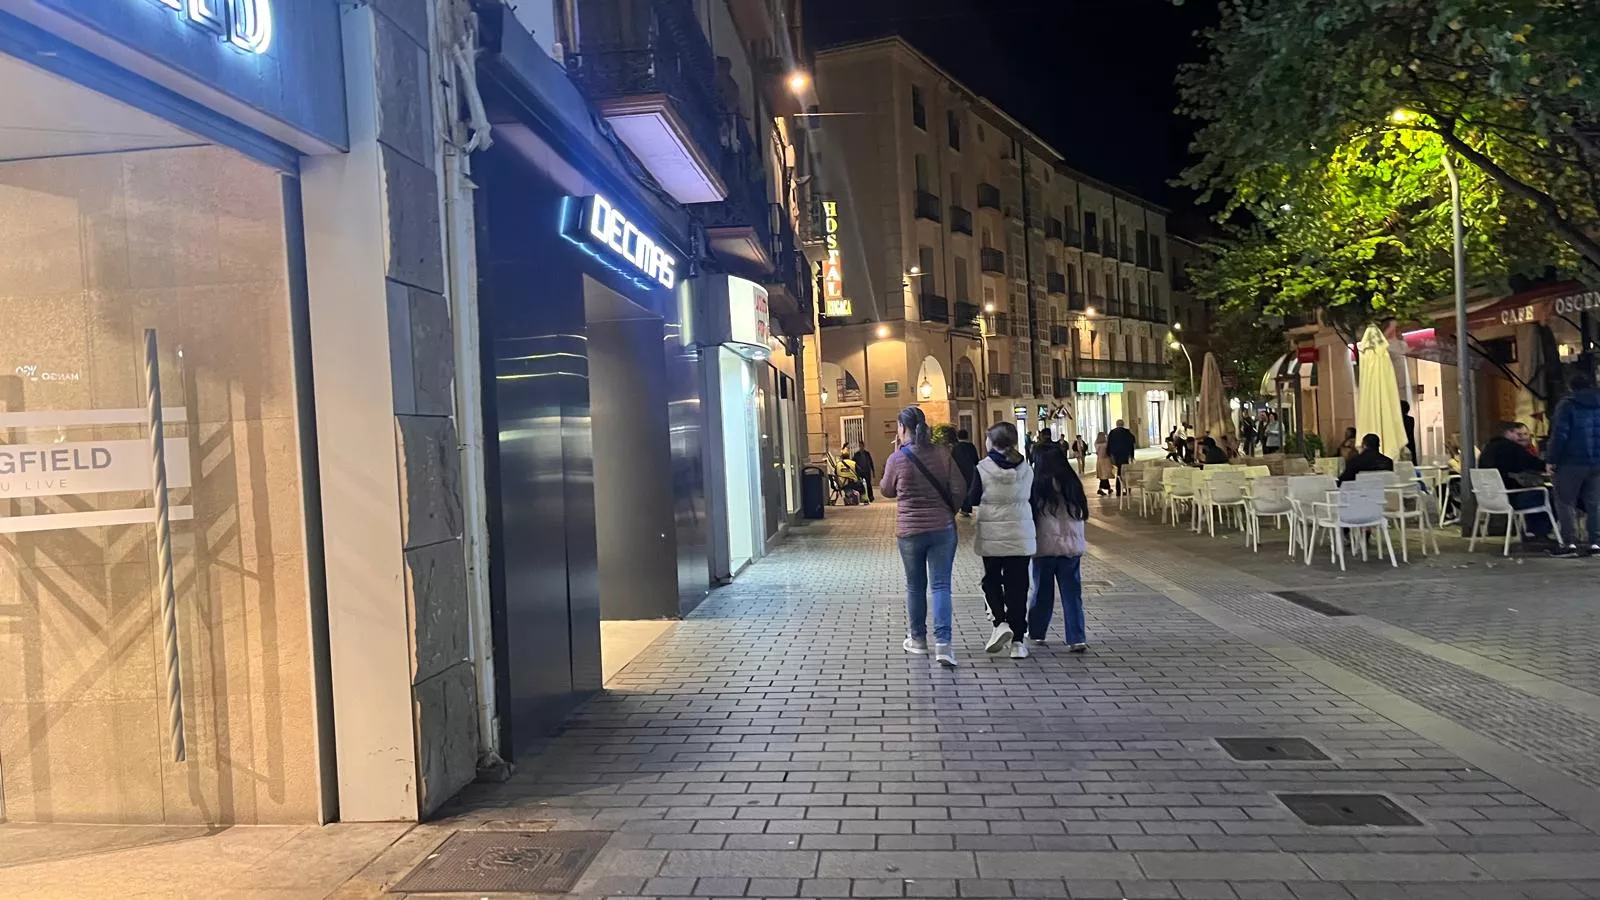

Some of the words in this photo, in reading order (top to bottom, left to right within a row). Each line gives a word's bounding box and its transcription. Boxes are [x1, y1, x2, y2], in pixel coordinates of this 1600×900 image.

[822, 201, 842, 297] HOSTAL
[0, 447, 112, 474] GFIELD
[25, 479, 68, 490] LIVE
